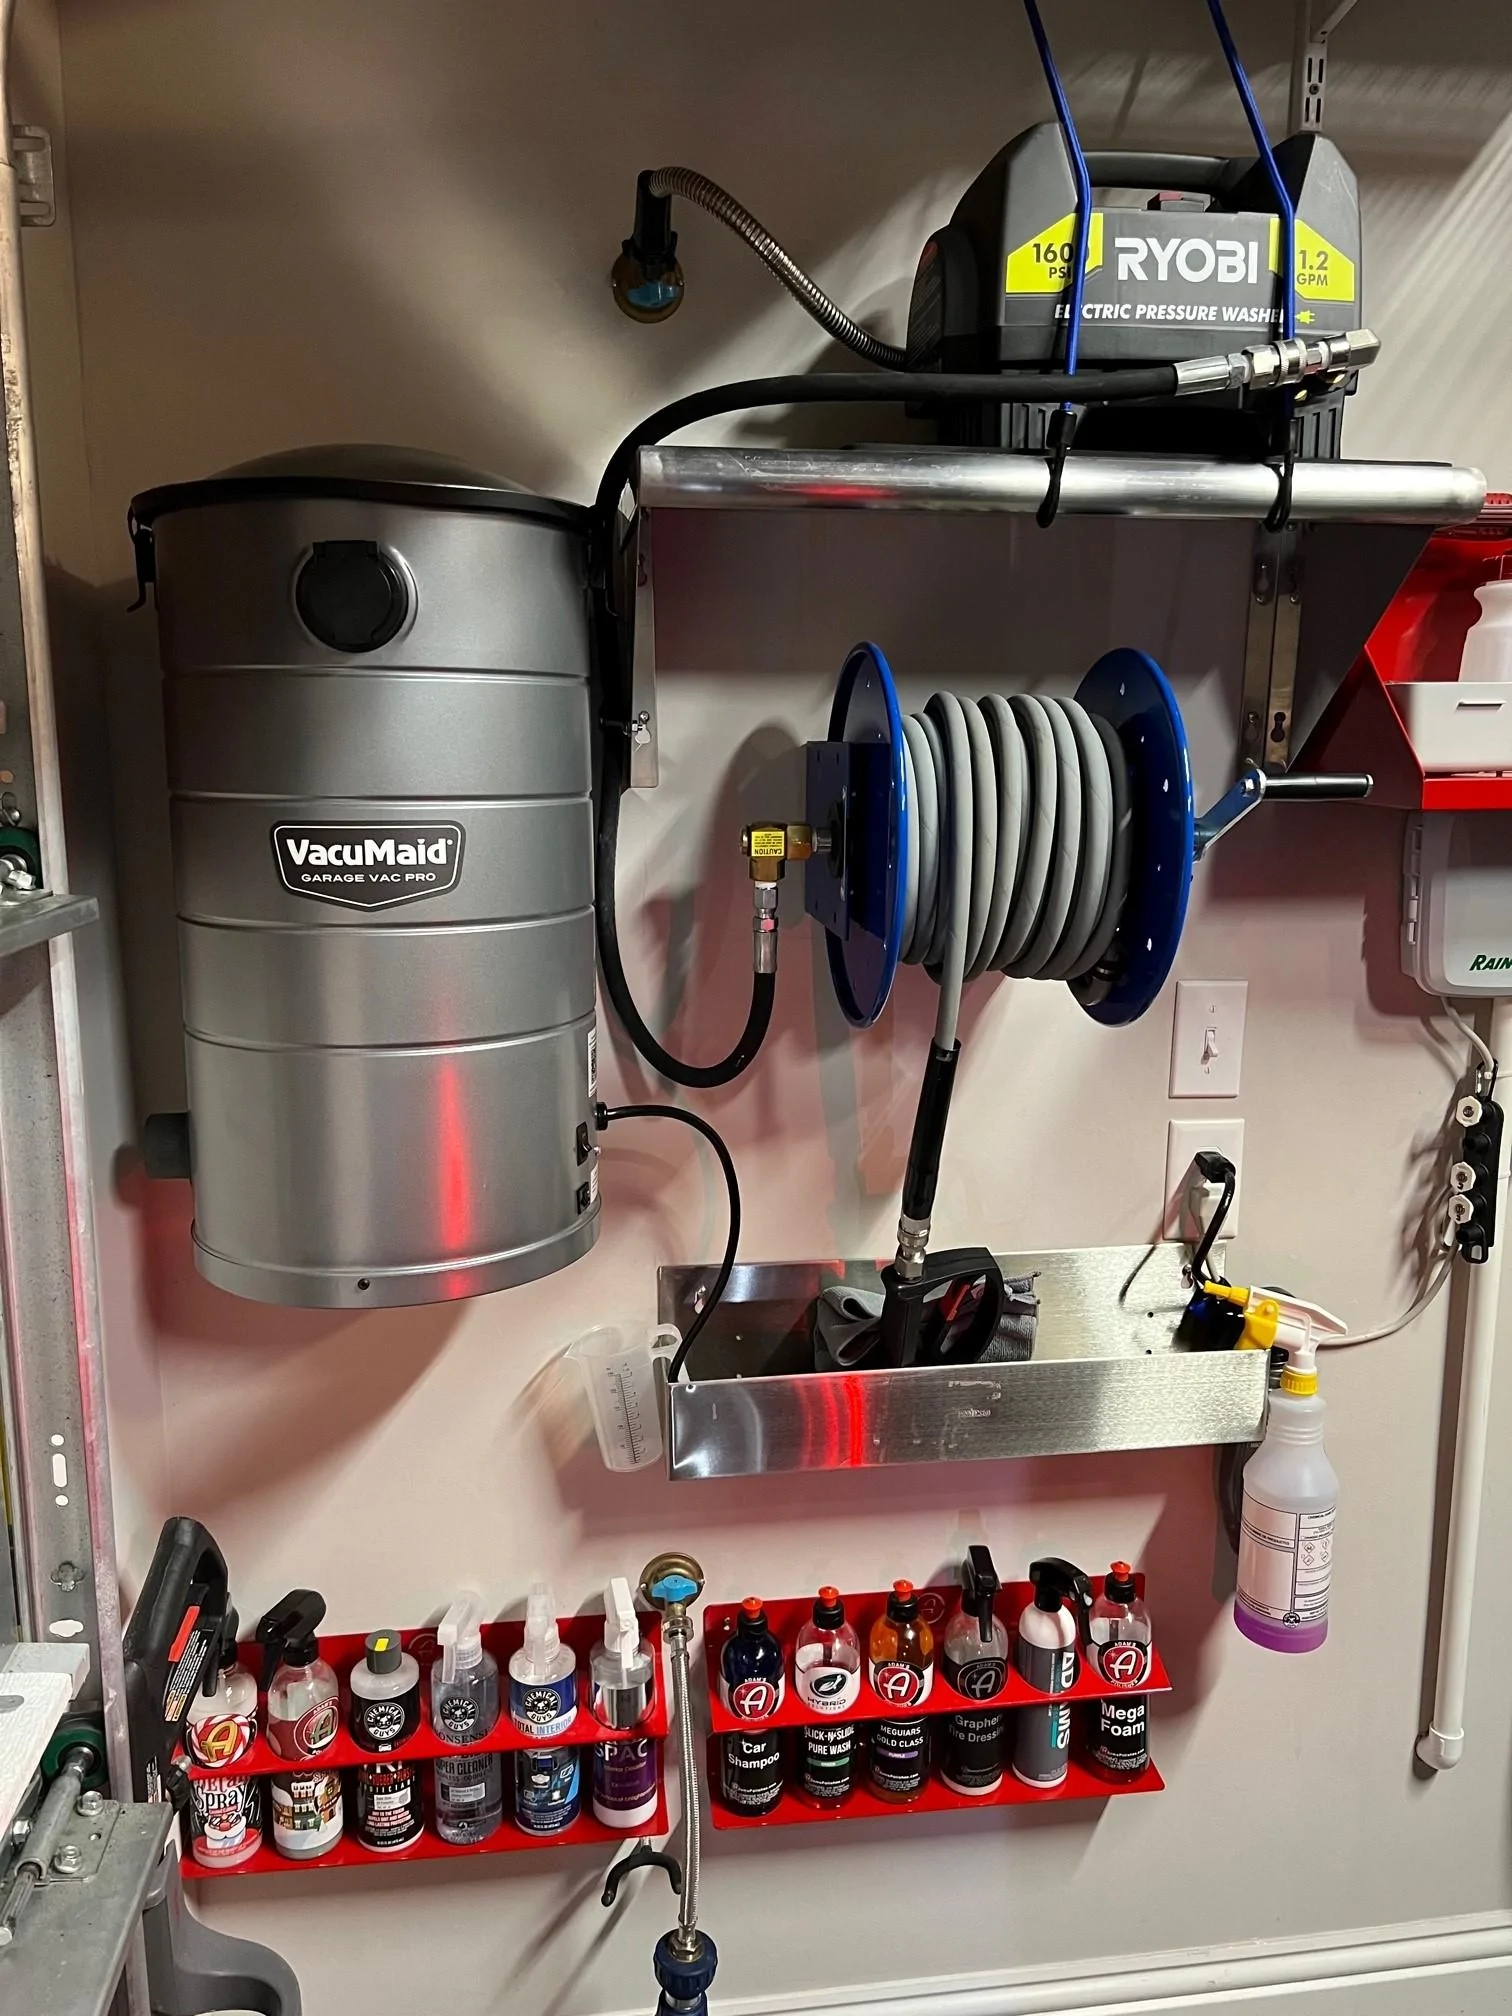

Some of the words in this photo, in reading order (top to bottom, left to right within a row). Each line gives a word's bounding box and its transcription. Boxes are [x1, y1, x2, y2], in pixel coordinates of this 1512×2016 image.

[1032, 242, 1090, 264] 160
[1299, 250, 1329, 271] 1.2
[1114, 238, 1258, 284] RYOBI
[1049, 266, 1072, 279] PSI
[1296, 273, 1329, 286] GPM
[1054, 303, 1131, 320] ELCTRIC
[1135, 304, 1218, 321] PRESSURE
[286, 838, 448, 866] VacuMaid
[301, 873, 365, 883] GARAGE
[369, 873, 401, 882] VAC
[405, 872, 436, 882] PRO
[442, 1699, 476, 1714] CHEMICAL
[525, 1691, 558, 1707] CHEMICAL
[807, 1697, 846, 1706] HYBRID
[367, 1705, 401, 1722] CHEMICAL
[531, 1712, 552, 1722] GUYS
[1101, 1704, 1145, 1723] Mega
[373, 1728, 396, 1737] GUYS
[448, 1721, 470, 1730] GUYS
[514, 1718, 535, 1734] TOTAL
[536, 1716, 572, 1734] INTERIOR
[880, 1725, 921, 1736] MEGUIARS
[1101, 1718, 1145, 1737] Foam
[743, 1742, 767, 1754] Car
[808, 1742, 828, 1755] PURE
[829, 1740, 851, 1755] WASH
[876, 1734, 897, 1747] GOLD
[899, 1736, 924, 1748] CLASS
[728, 1752, 780, 1770] Shampoo
